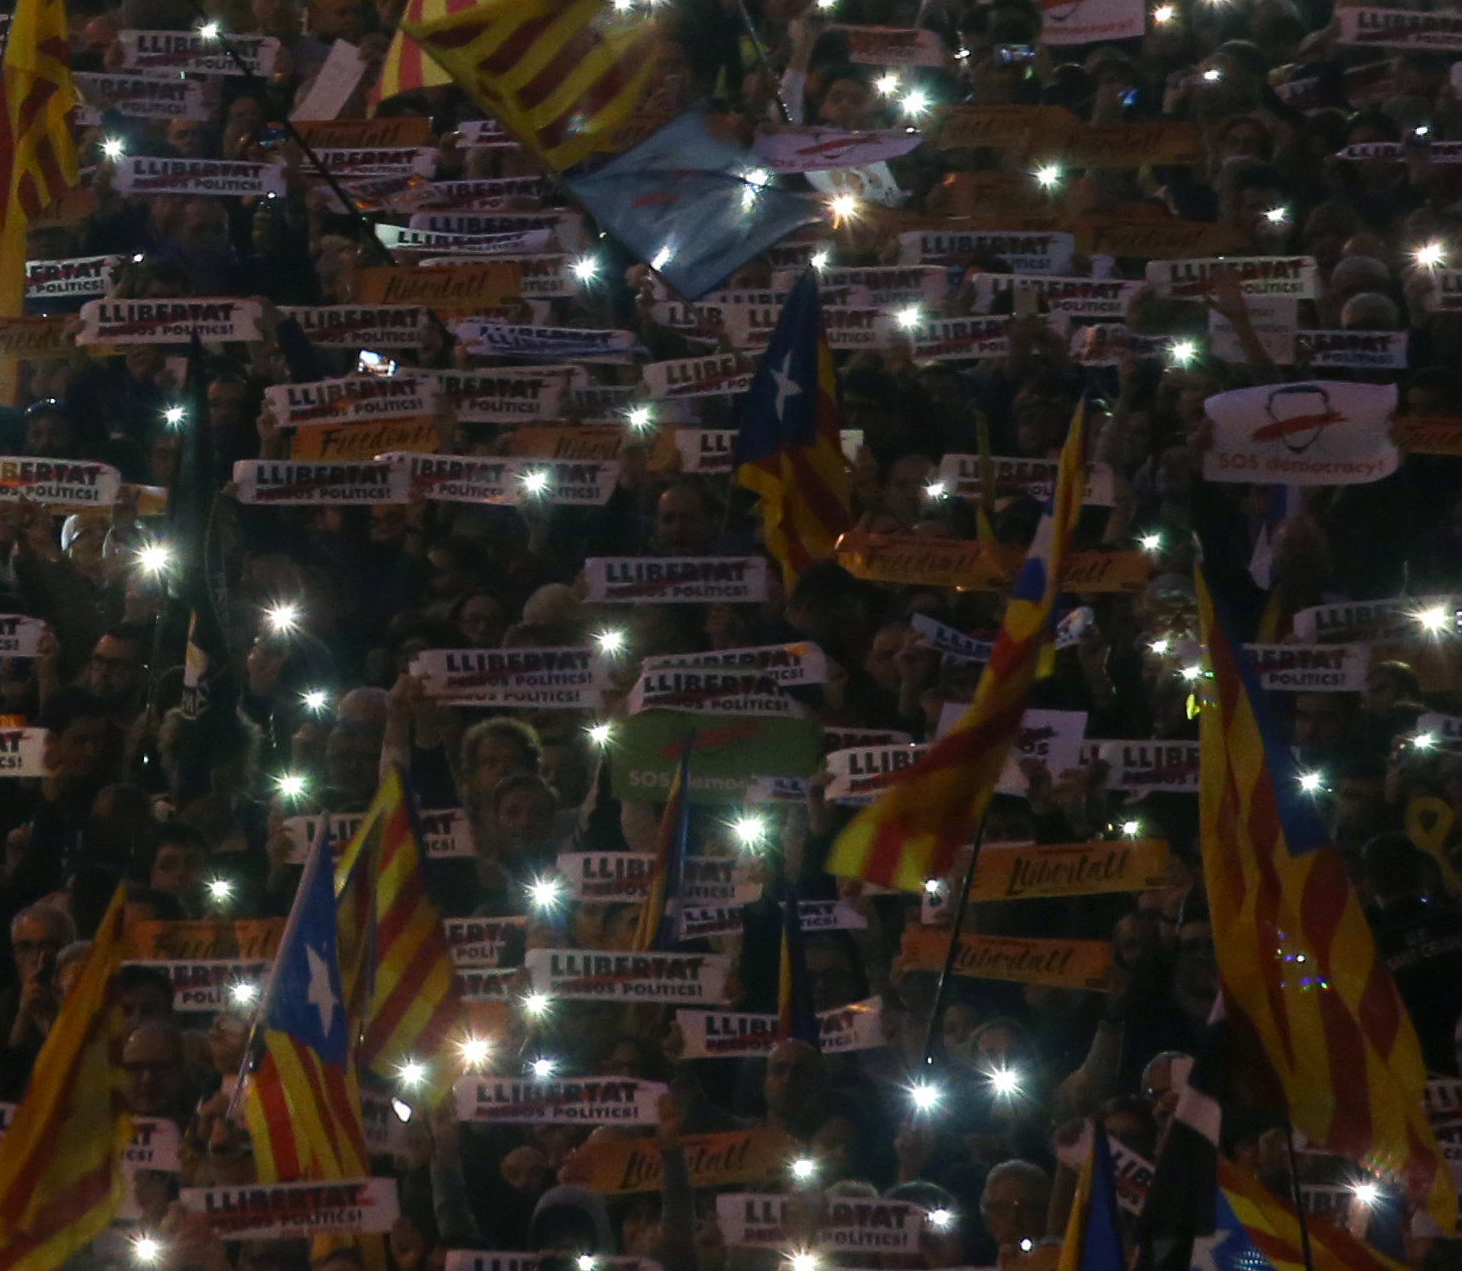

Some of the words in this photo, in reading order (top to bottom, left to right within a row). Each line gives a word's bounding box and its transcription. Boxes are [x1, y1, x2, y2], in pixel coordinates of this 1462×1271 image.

[289, 384, 423, 405] LLIBERTAT
[256, 465, 391, 484] LLIBERTAT
[605, 562, 747, 582] LLIBERTAT
[447, 652, 593, 672] LLIBERTAT
[550, 955, 703, 980] LLIBERTAT
[477, 1082, 637, 1104] LLIBERTAT
[205, 1185, 363, 1211] LLIBERTAT
